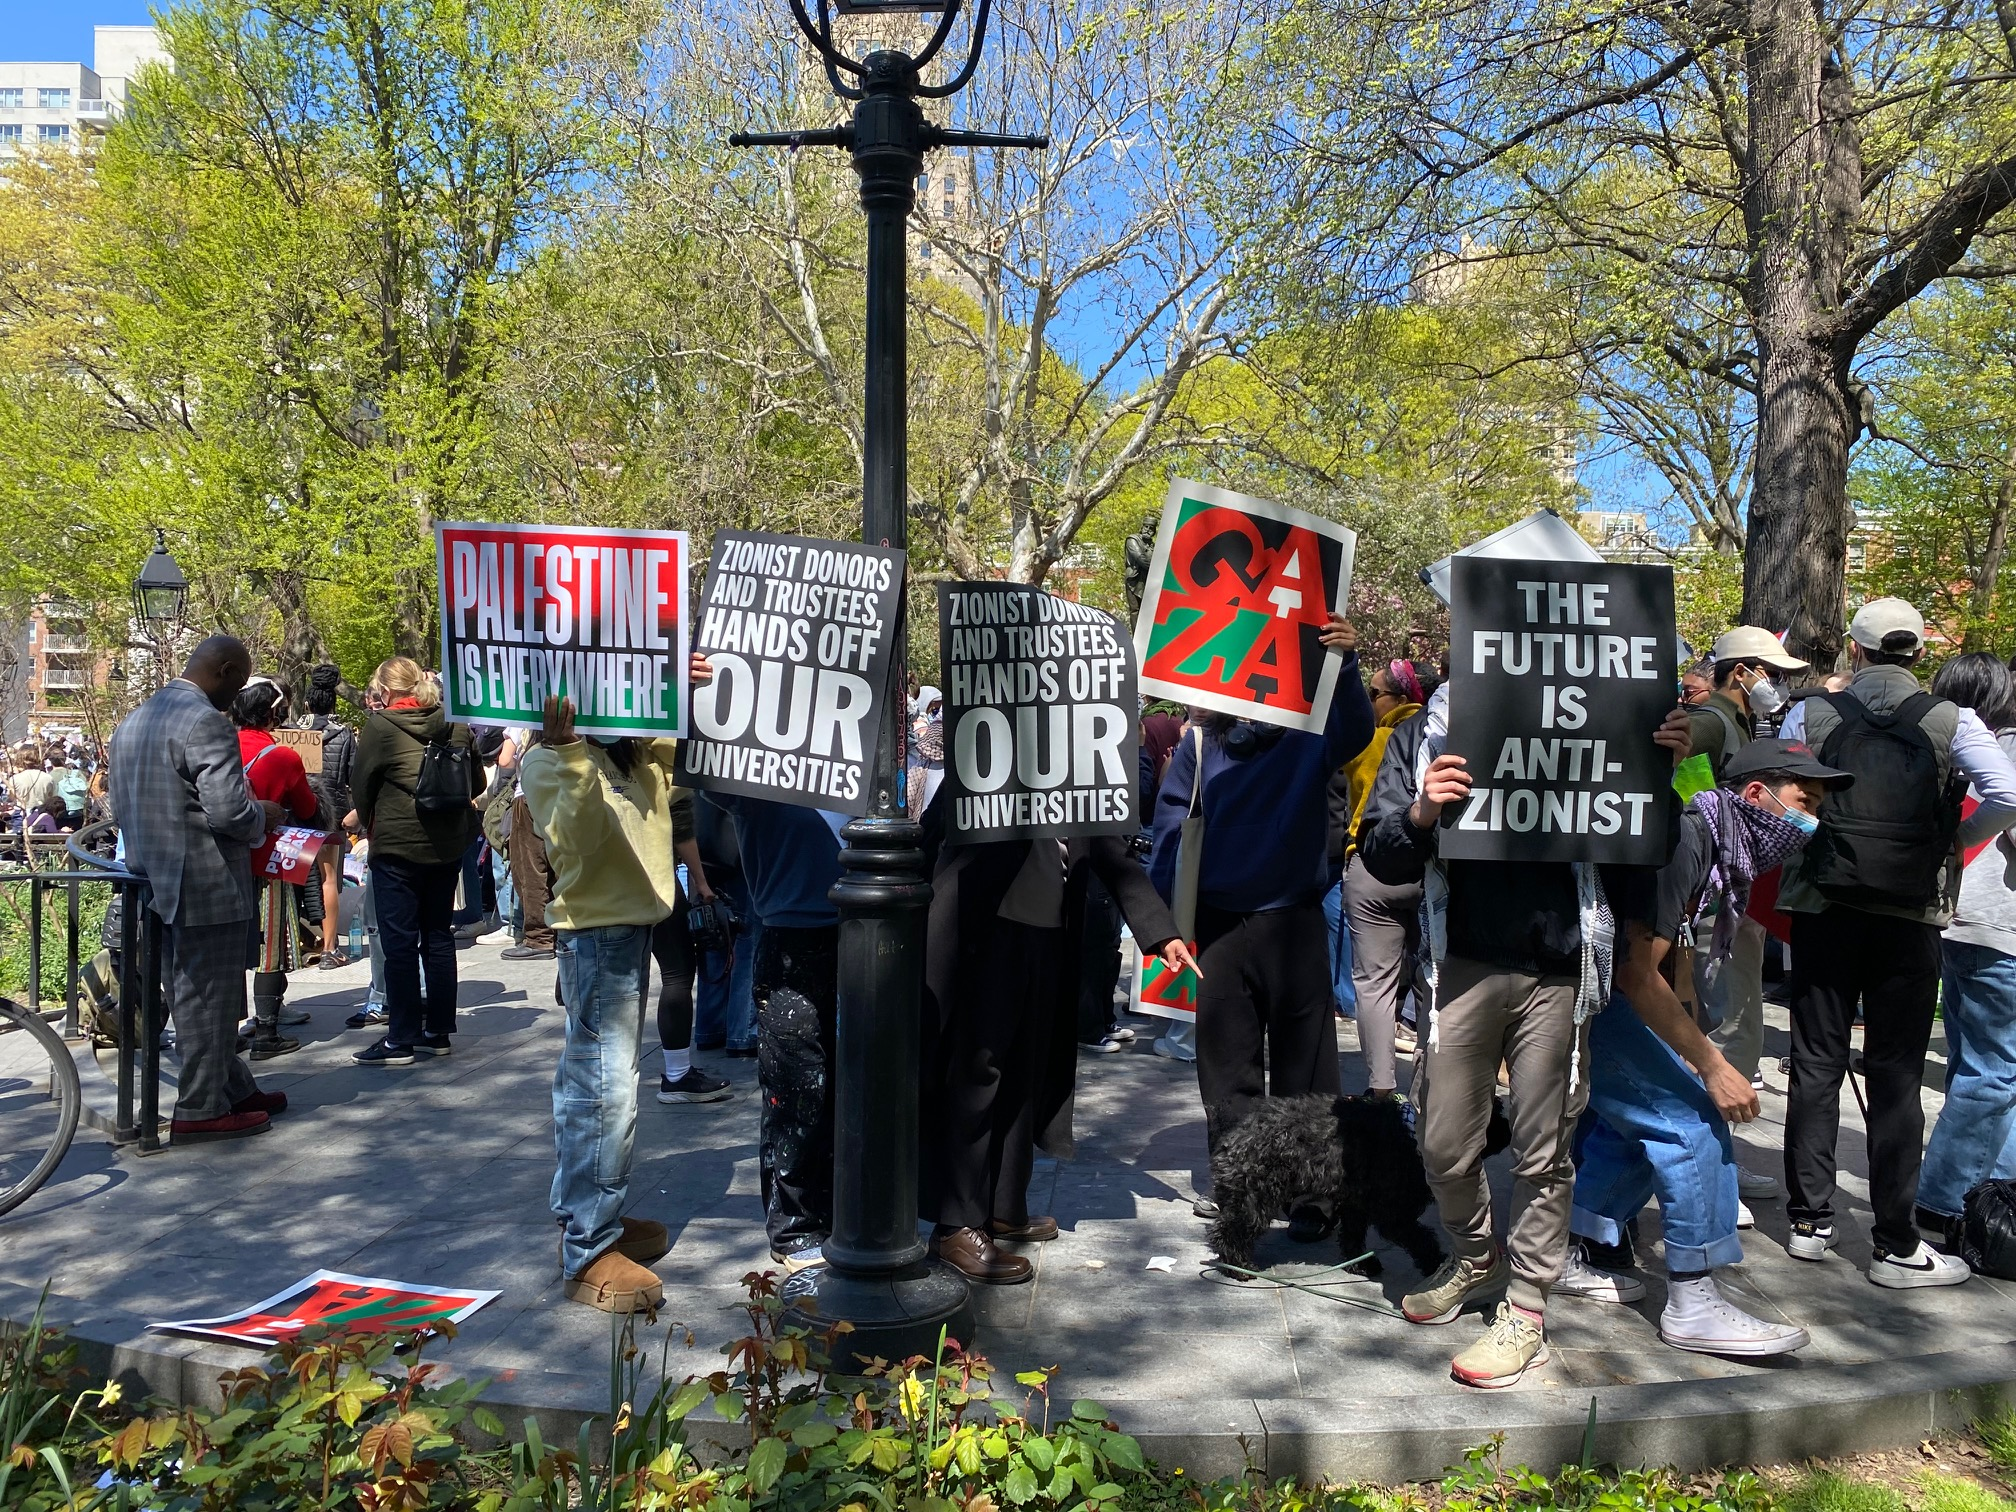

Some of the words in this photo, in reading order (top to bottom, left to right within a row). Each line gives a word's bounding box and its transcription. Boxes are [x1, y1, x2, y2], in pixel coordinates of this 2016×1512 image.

[718, 539, 801, 578] ZIONIST
[803, 551, 892, 592] DONORS
[453, 541, 669, 650] PALESTINE
[710, 573, 757, 609] AND
[764, 578, 883, 631] TRUSTEES,
[949, 591, 1030, 626] ZIONIST
[1516, 580, 1611, 626] THE
[700, 606, 809, 662] HANDS
[817, 624, 882, 671] OFF
[951, 626, 997, 661] AND
[1004, 624, 1126, 659] TRUSTEES,
[1473, 630, 1658, 679] FUTURE
[455, 643, 483, 707] IS
[487, 645, 669, 719] EVERYWHERE
[951, 660, 1060, 706] HANDS
[1068, 658, 1127, 701] OFF
[694, 652, 873, 762] OUR
[1541, 685, 1588, 729] IS
[685, 739, 862, 801] UNIVERSITIES
[954, 703, 1128, 793] OUR
[1493, 737, 1623, 783] ANTI-
[956, 788, 1130, 831] UNIVERSITIES
[1457, 788, 1654, 836] ZIONIST
